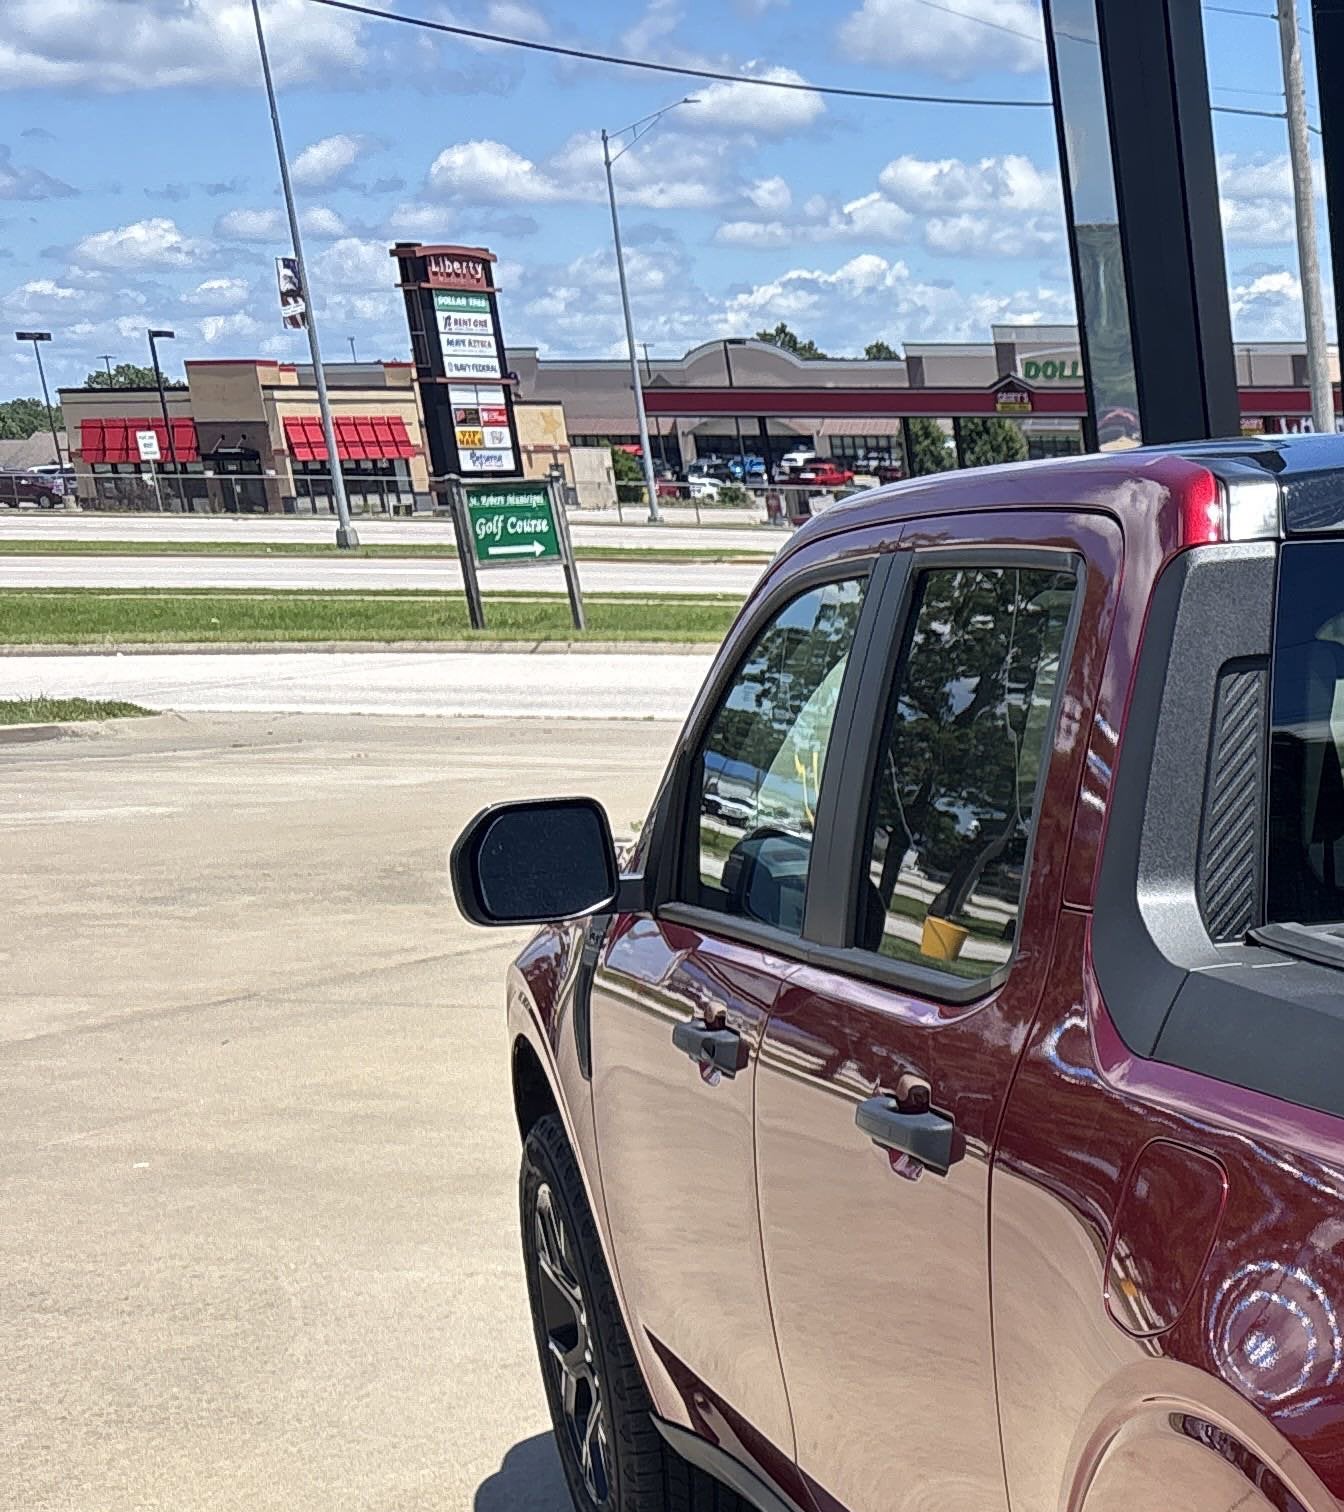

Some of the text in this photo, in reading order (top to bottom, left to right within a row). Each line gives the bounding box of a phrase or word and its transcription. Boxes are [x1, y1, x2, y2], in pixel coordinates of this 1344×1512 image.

[430, 255, 483, 278] Liberty
[475, 515, 549, 541] Golf Course
